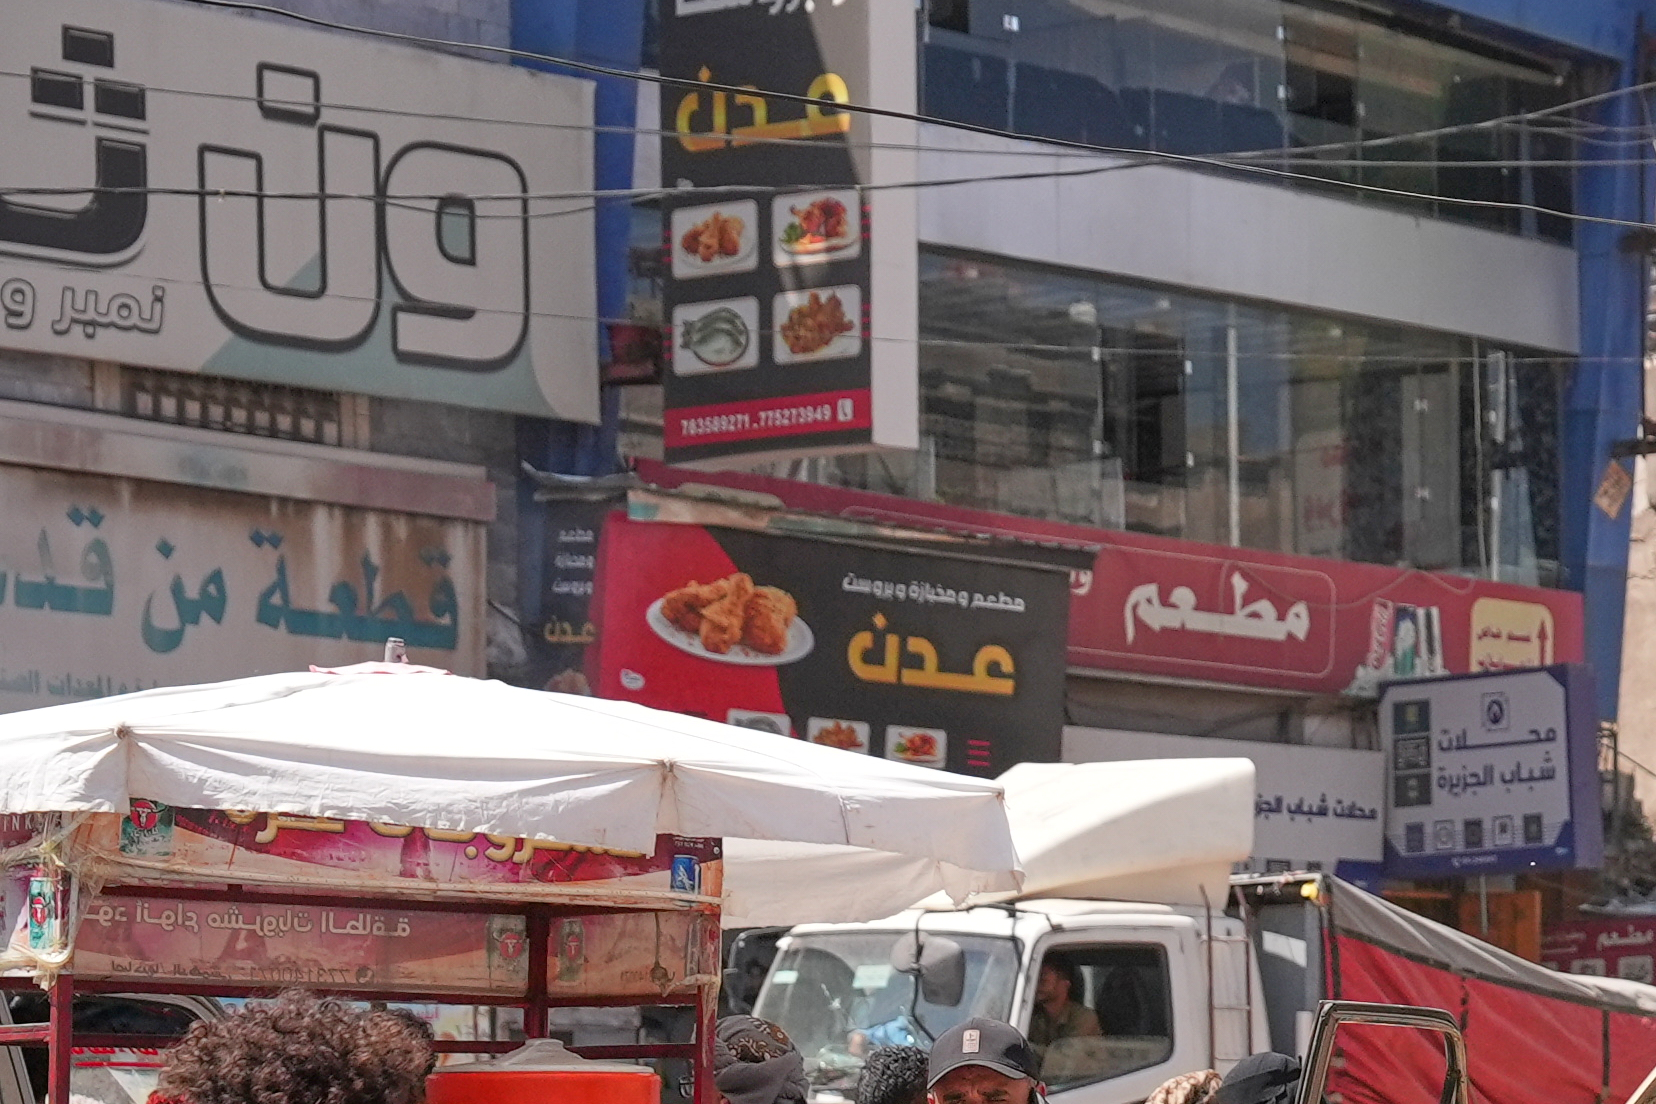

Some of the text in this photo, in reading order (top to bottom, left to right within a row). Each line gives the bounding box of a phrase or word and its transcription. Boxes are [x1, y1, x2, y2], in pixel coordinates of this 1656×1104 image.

[675, 64, 851, 152] عدن
[2, 277, 166, 338] نمبر و
[141, 535, 227, 653] من
[255, 527, 459, 650] قطعة
[970, 591, 1026, 613] مطعم
[1124, 571, 1311, 646] مطعم
[847, 609, 1016, 697] عدن
[1437, 725, 1557, 751] محلات
[1437, 751, 1557, 797] شباب الجزيرة
[1254, 793, 1284, 822] الجز
[1286, 792, 1330, 824] شباب
